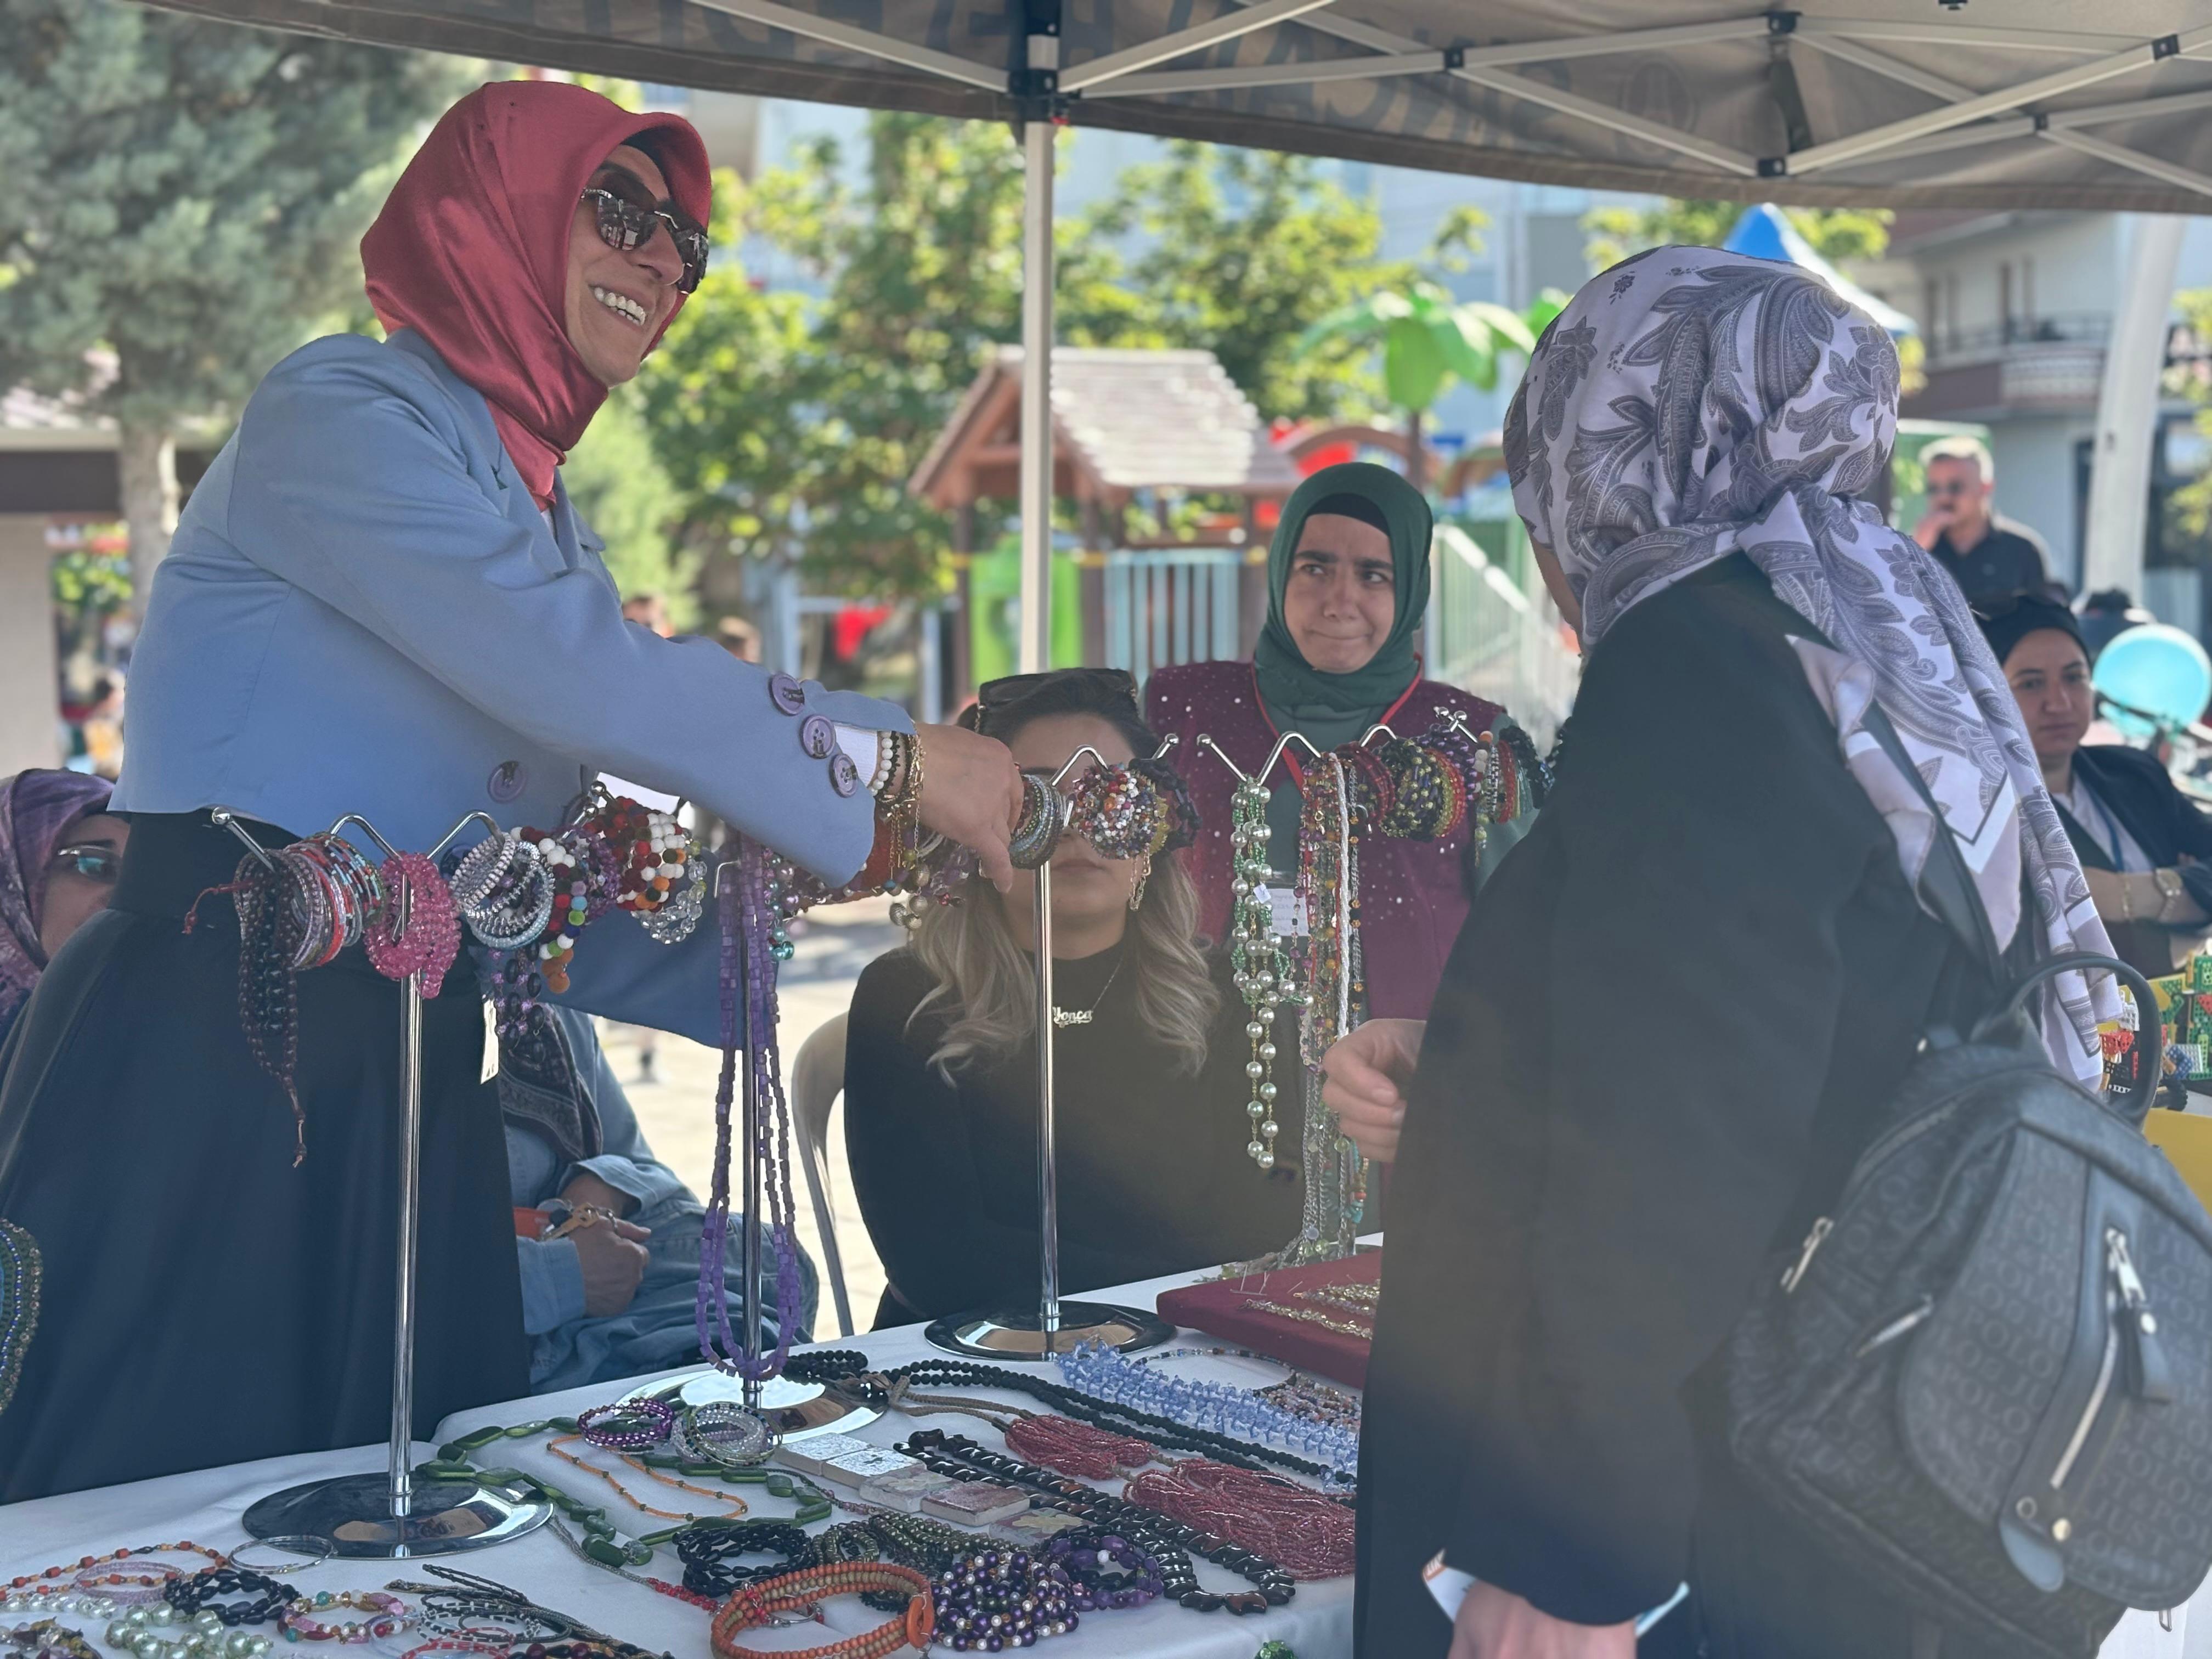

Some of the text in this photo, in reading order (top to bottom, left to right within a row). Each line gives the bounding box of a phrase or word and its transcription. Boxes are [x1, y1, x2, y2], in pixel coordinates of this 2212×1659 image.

[1958, 1304, 2058, 1382] POLO
[1936, 1362, 2035, 1439] POLO
[2083, 1495, 2171, 1560] JUST
